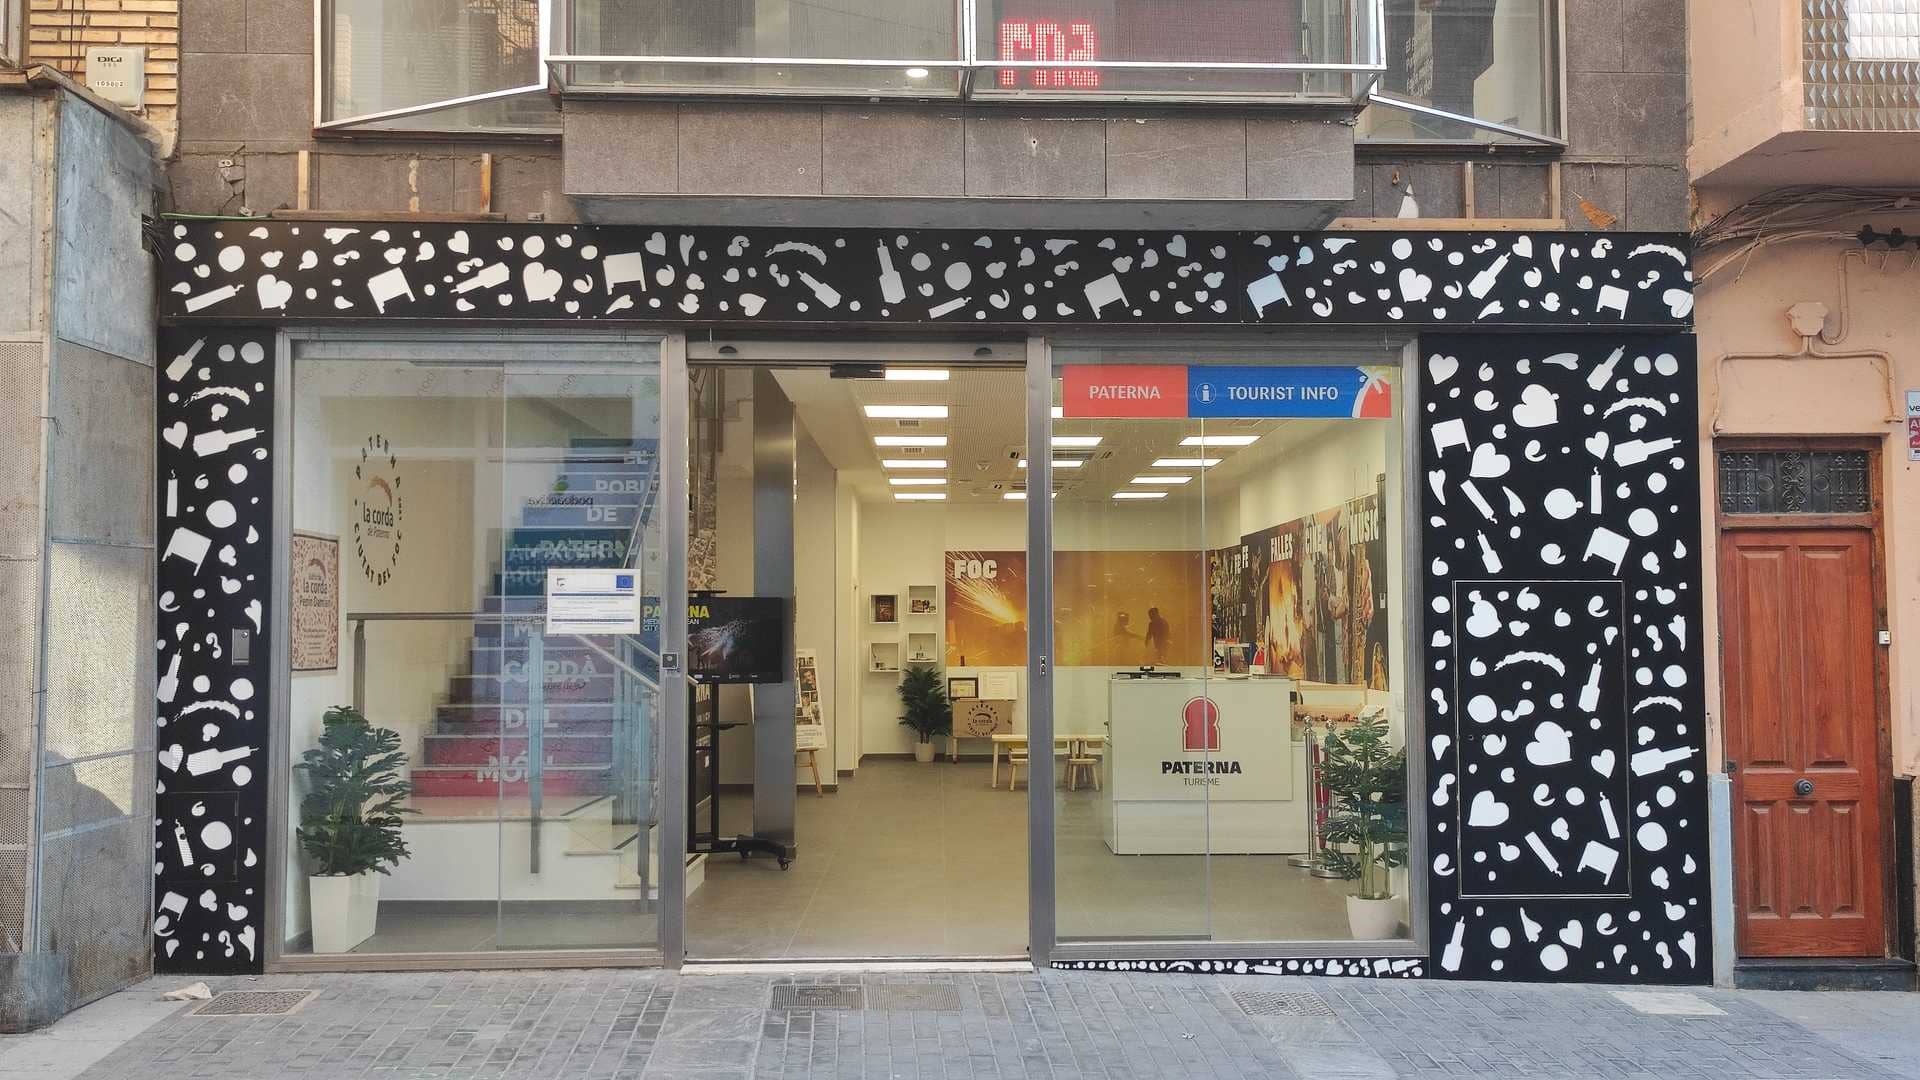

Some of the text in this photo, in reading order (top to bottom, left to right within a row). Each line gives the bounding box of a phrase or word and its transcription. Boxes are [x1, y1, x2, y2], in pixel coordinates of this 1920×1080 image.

[1089, 385, 1161, 400] PATERNA
[1228, 385, 1338, 401] TOURIST INFO
[363, 502, 371, 523] la
[372, 504, 394, 527] corda
[586, 507, 617, 522] DE
[1270, 533, 1294, 562] FALLES
[377, 567, 391, 586] DEL
[953, 559, 998, 580] FOC
[643, 605, 710, 618] PANA
[505, 708, 560, 729] DL
[1161, 760, 1242, 774] PATERNA
[1183, 777, 1220, 786] TURISME
